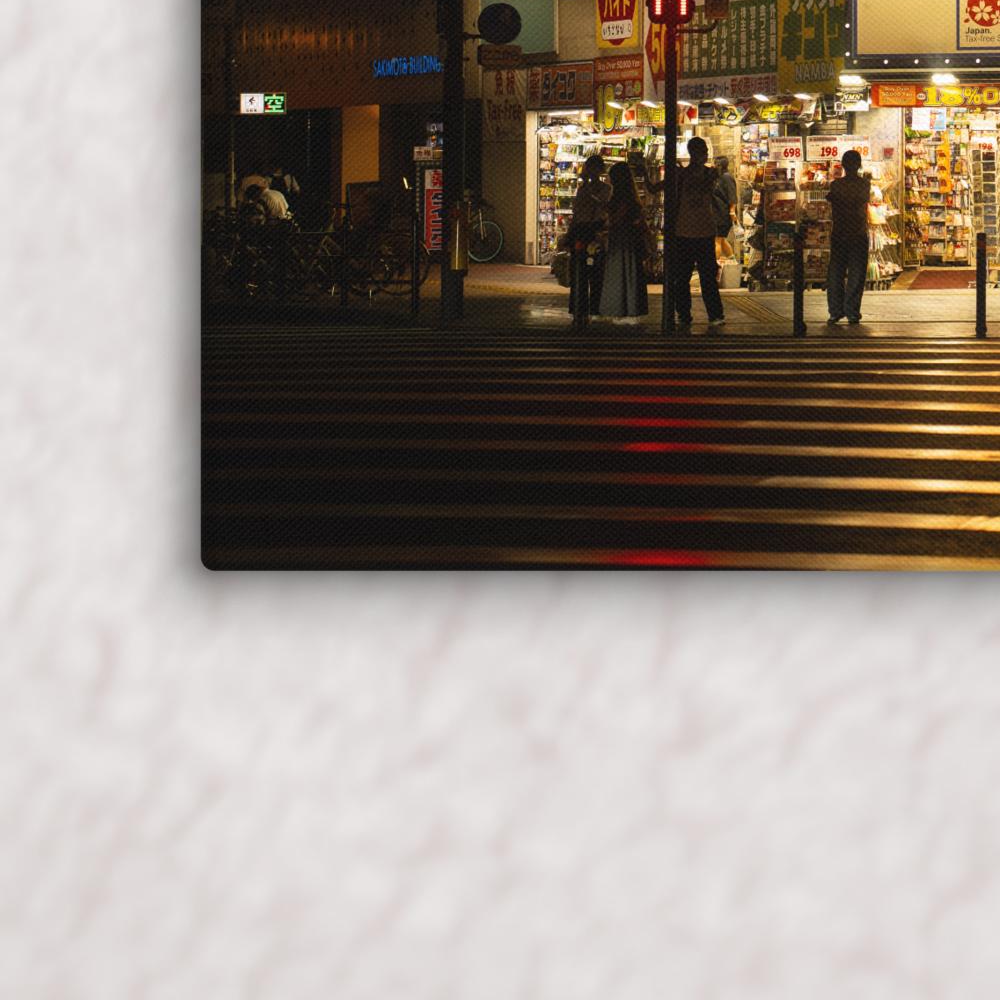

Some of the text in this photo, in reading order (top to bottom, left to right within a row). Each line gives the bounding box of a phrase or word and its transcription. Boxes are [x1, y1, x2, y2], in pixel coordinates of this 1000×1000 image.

[965, 26, 992, 36] Japan.
[795, 62, 836, 83] NAMBA
[264, 93, 285, 113] 空
[783, 147, 801, 158] 698
[821, 146, 838, 157] 198
